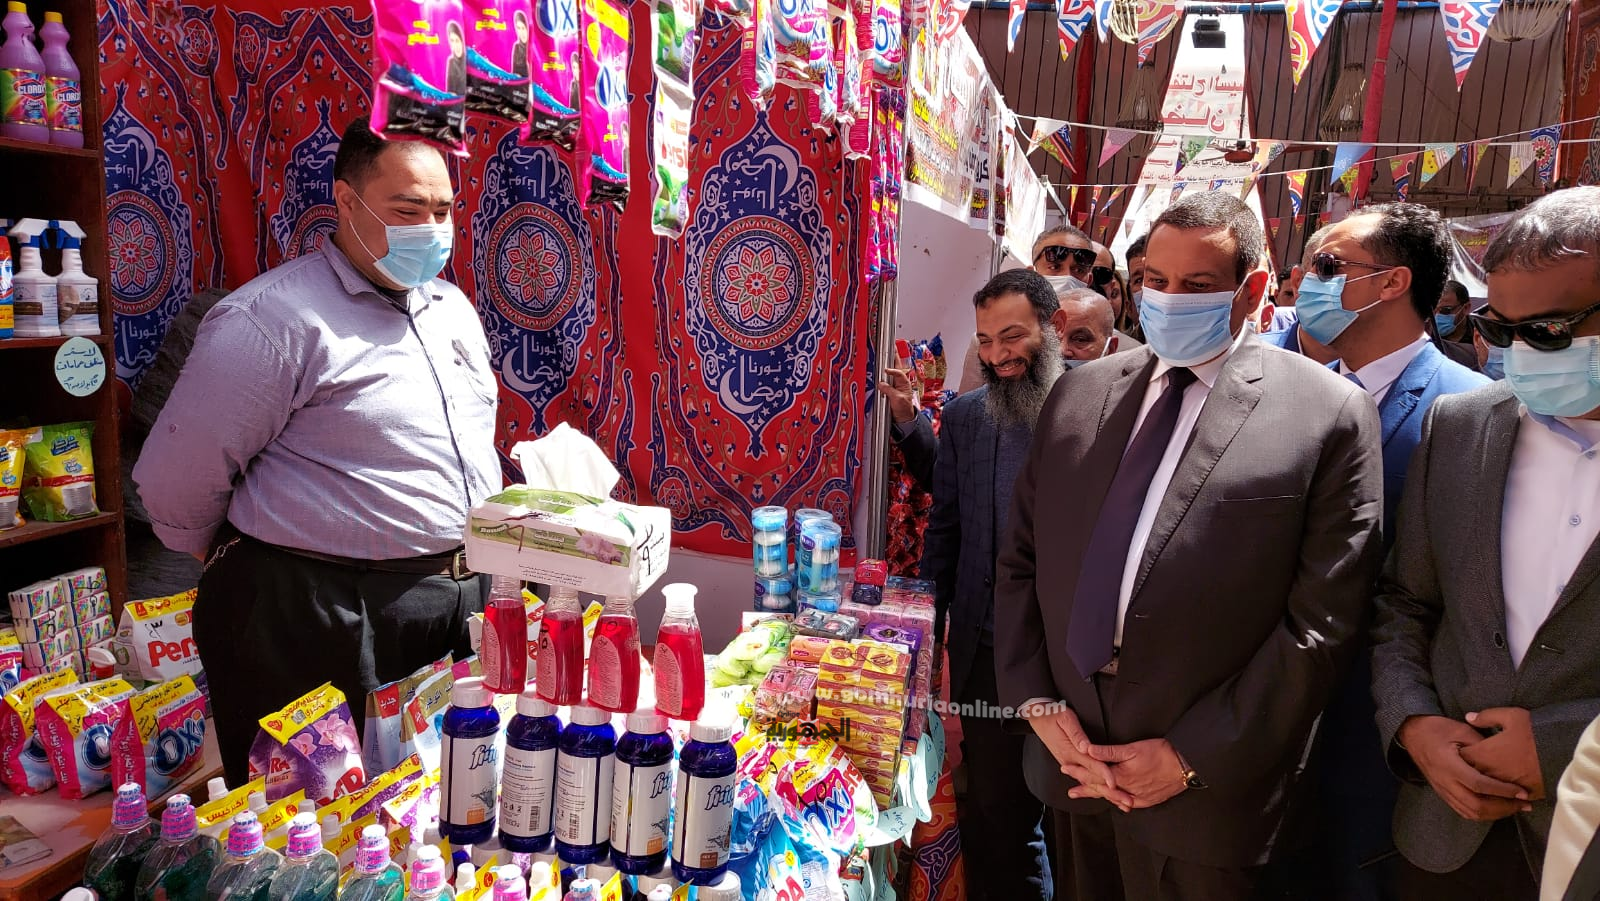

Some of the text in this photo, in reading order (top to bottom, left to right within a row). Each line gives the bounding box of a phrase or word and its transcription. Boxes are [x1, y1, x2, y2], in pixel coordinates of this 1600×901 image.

[732, 186, 766, 209] نورنا
[531, 335, 557, 354] نورنا
[748, 356, 782, 376] نورنا
[147, 637, 200, 668] Per
